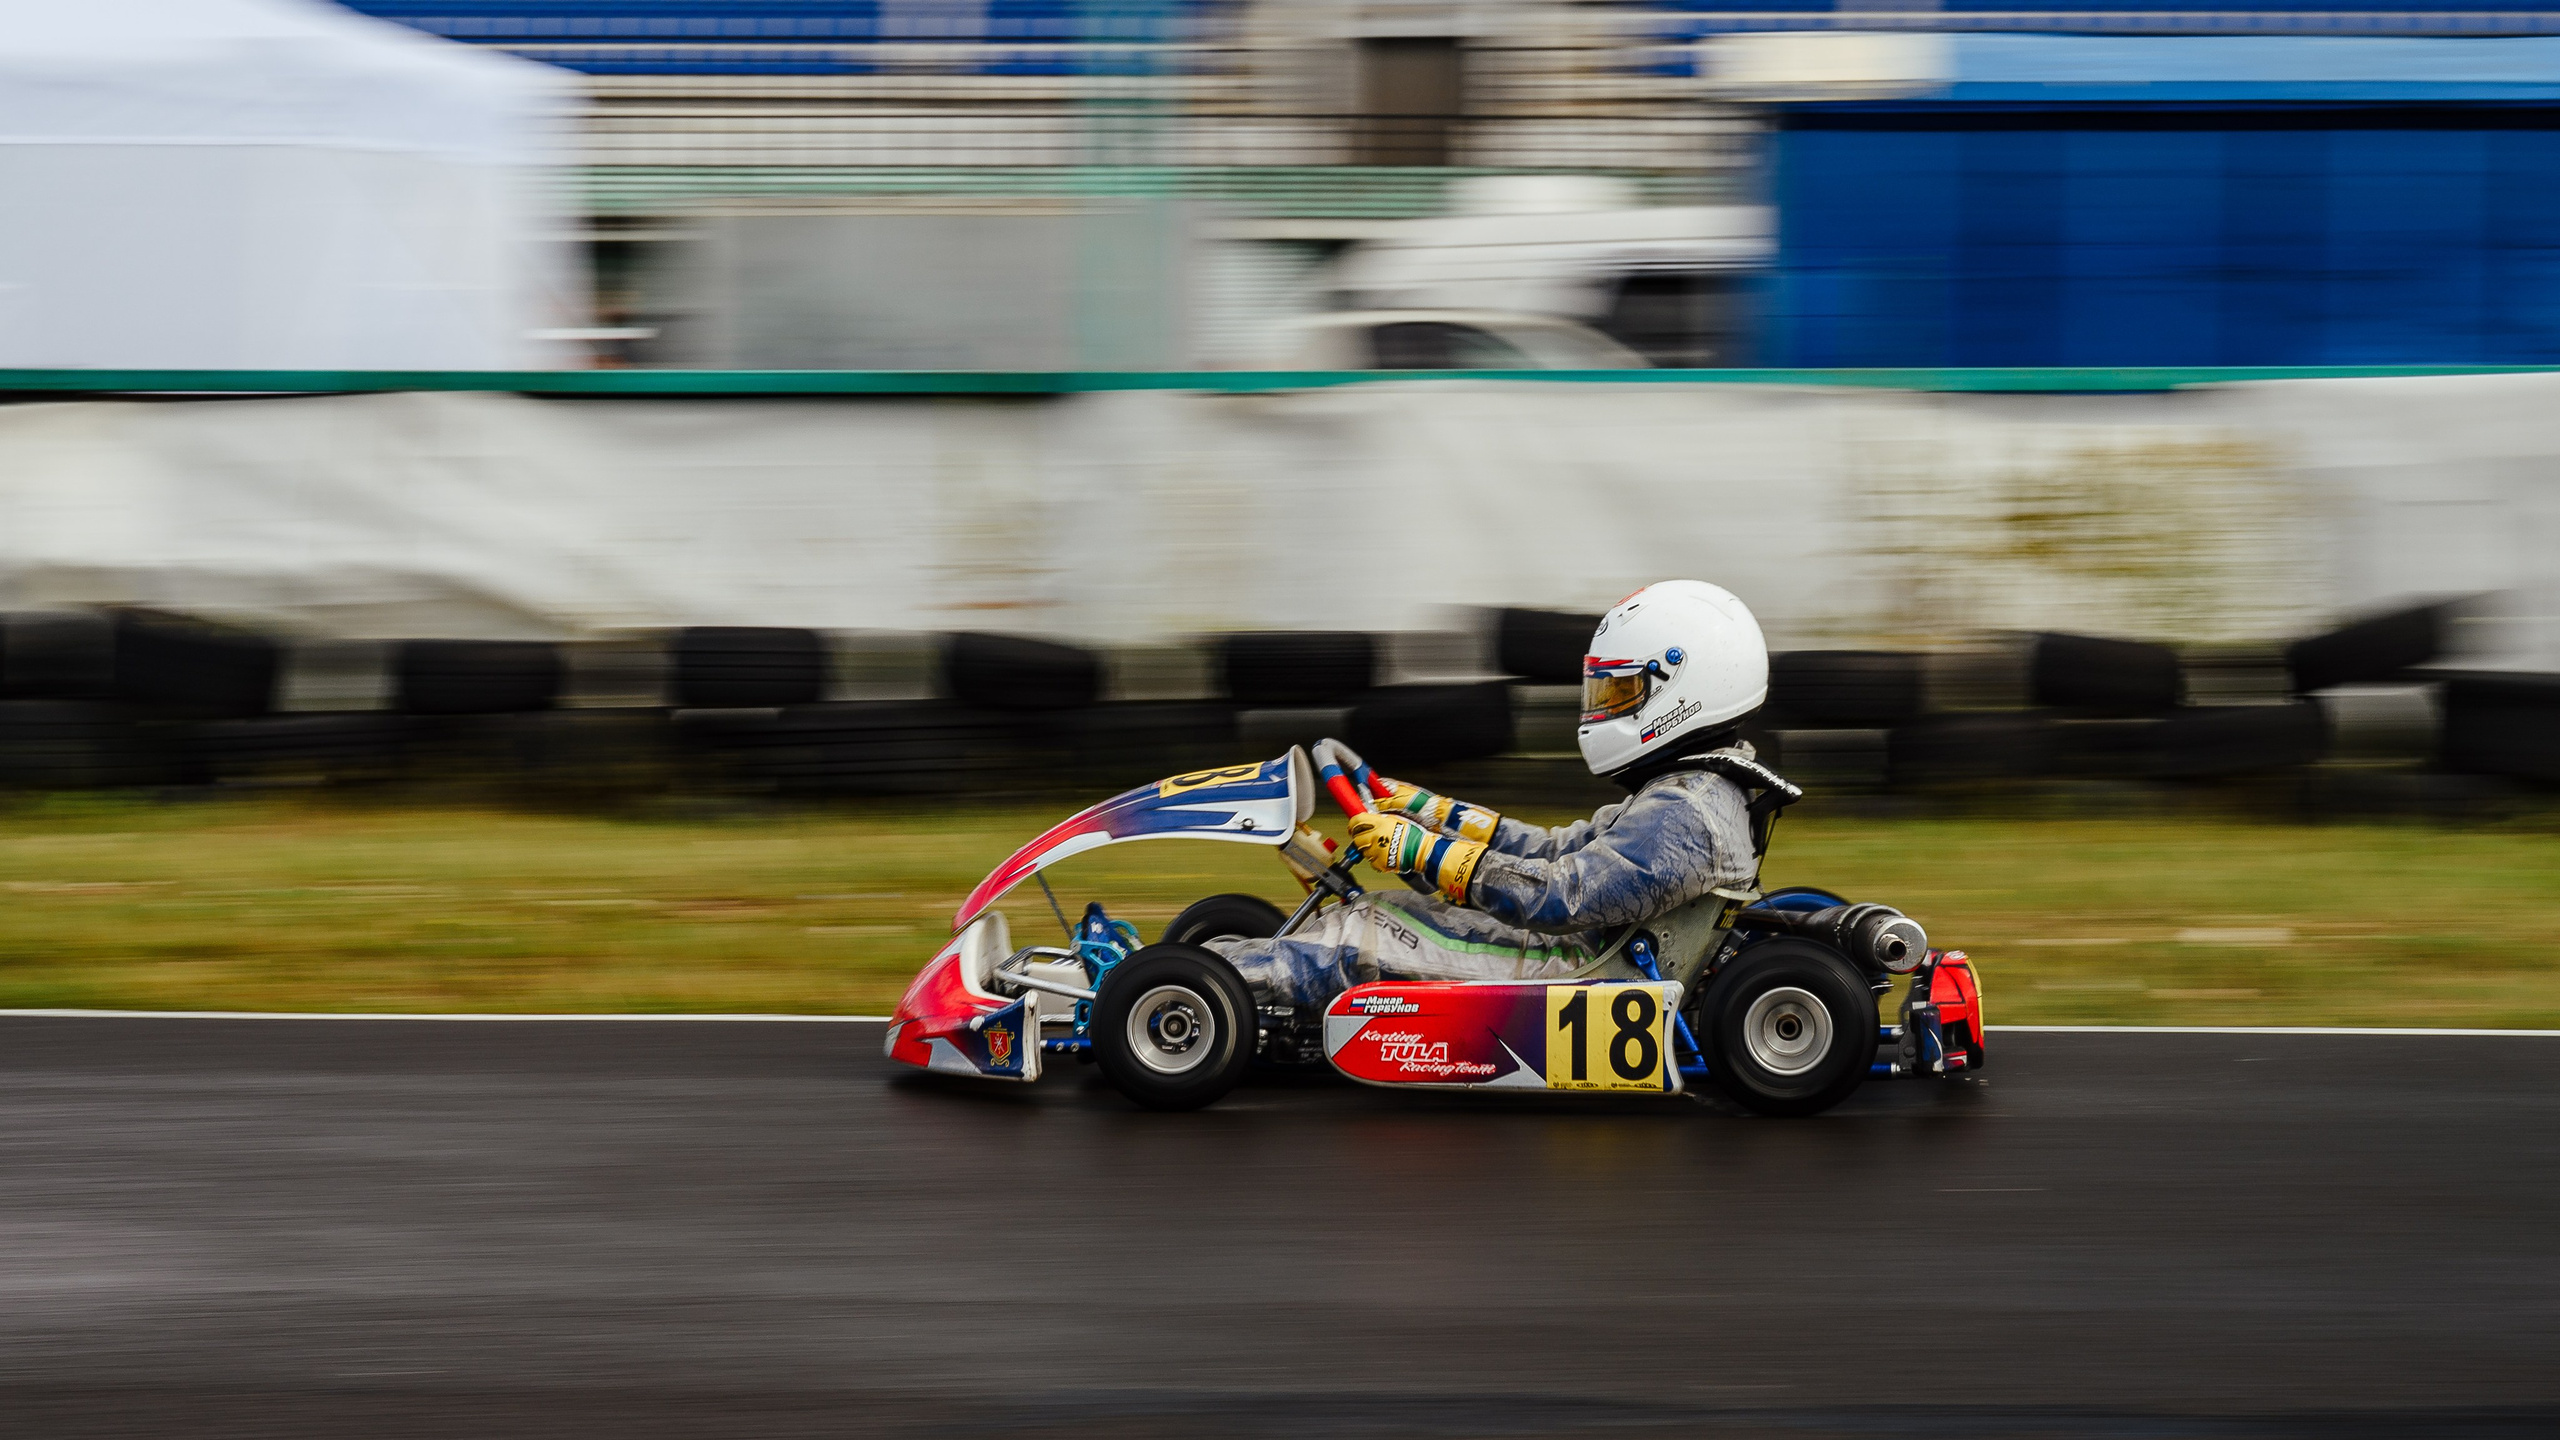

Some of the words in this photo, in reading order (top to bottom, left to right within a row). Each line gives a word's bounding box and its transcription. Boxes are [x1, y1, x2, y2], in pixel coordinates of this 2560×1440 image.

[1653, 706, 1685, 730] Макар
[1655, 702, 1701, 738] ГОРБУНОВ
[1363, 1003, 1420, 1014] ГОРБУНОВ
[1366, 995, 1404, 1008] Макар
[1360, 1030, 1424, 1045] Karting
[1558, 989, 1658, 1081] 18
[1381, 1042, 1449, 1062] TULA
